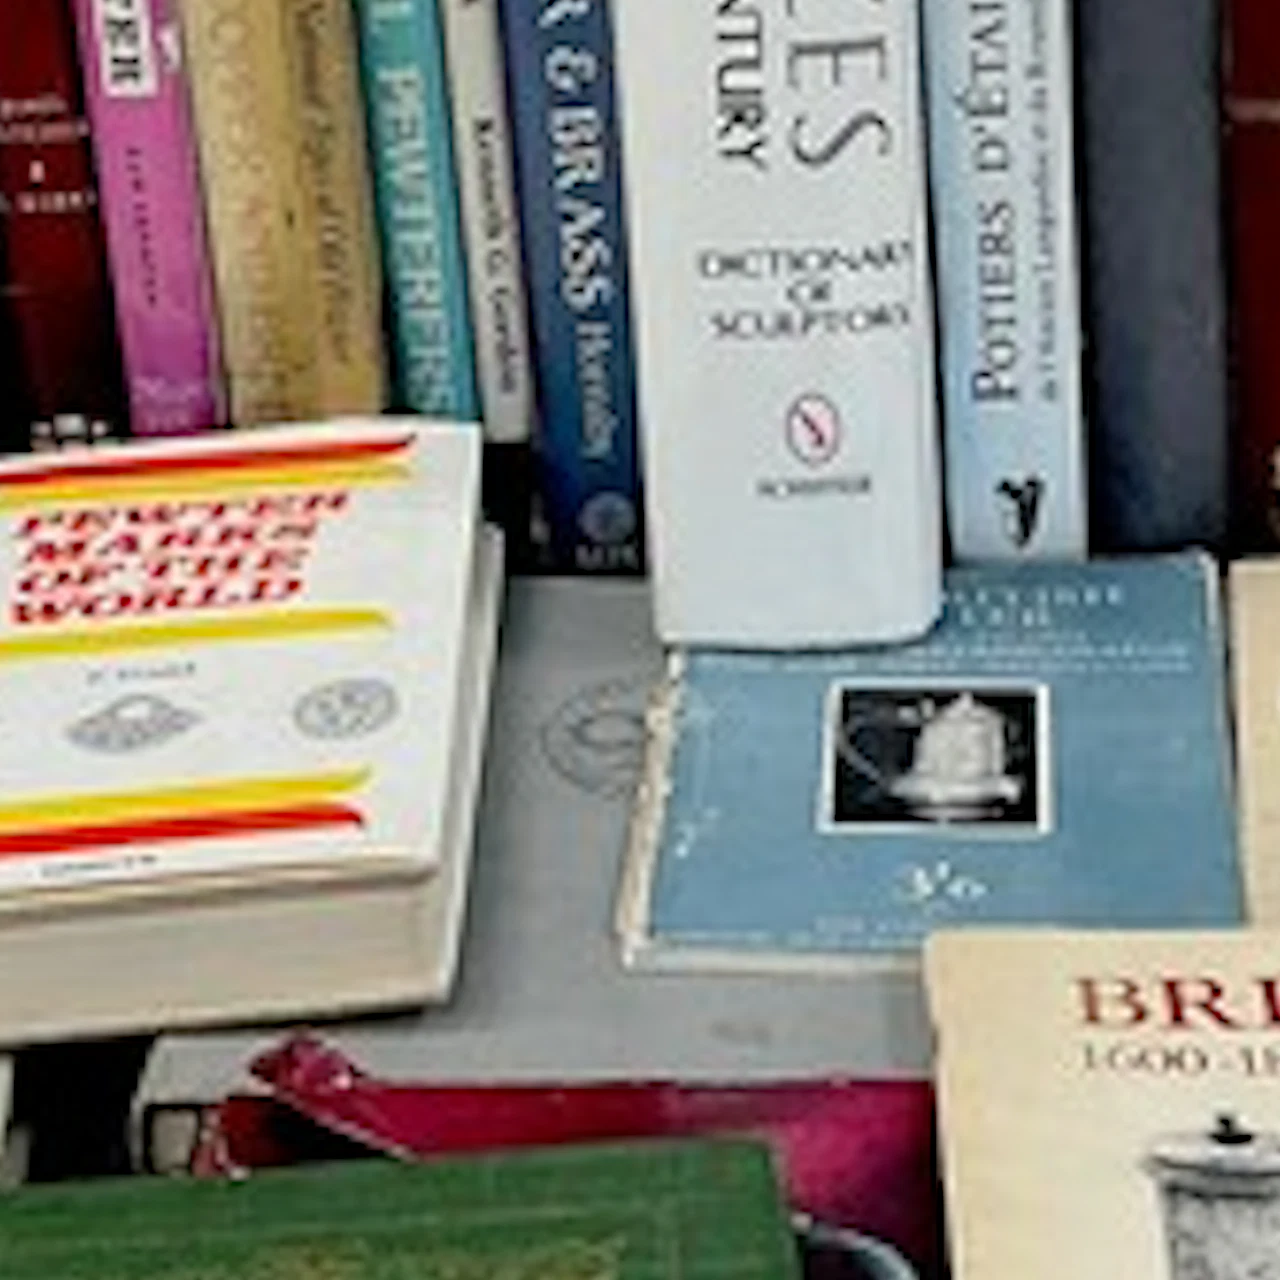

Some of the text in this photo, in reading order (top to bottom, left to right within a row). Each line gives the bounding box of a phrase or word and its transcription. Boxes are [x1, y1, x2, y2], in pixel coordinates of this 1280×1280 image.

[543, 45, 597, 96] &
[547, 106, 614, 314] BRASS
[967, 199, 1021, 407] POTIERS
[14, 490, 351, 540] PEWTER
[20, 520, 317, 566] MARKS
[14, 547, 310, 597] OF THE
[10, 577, 306, 624] WORLD
